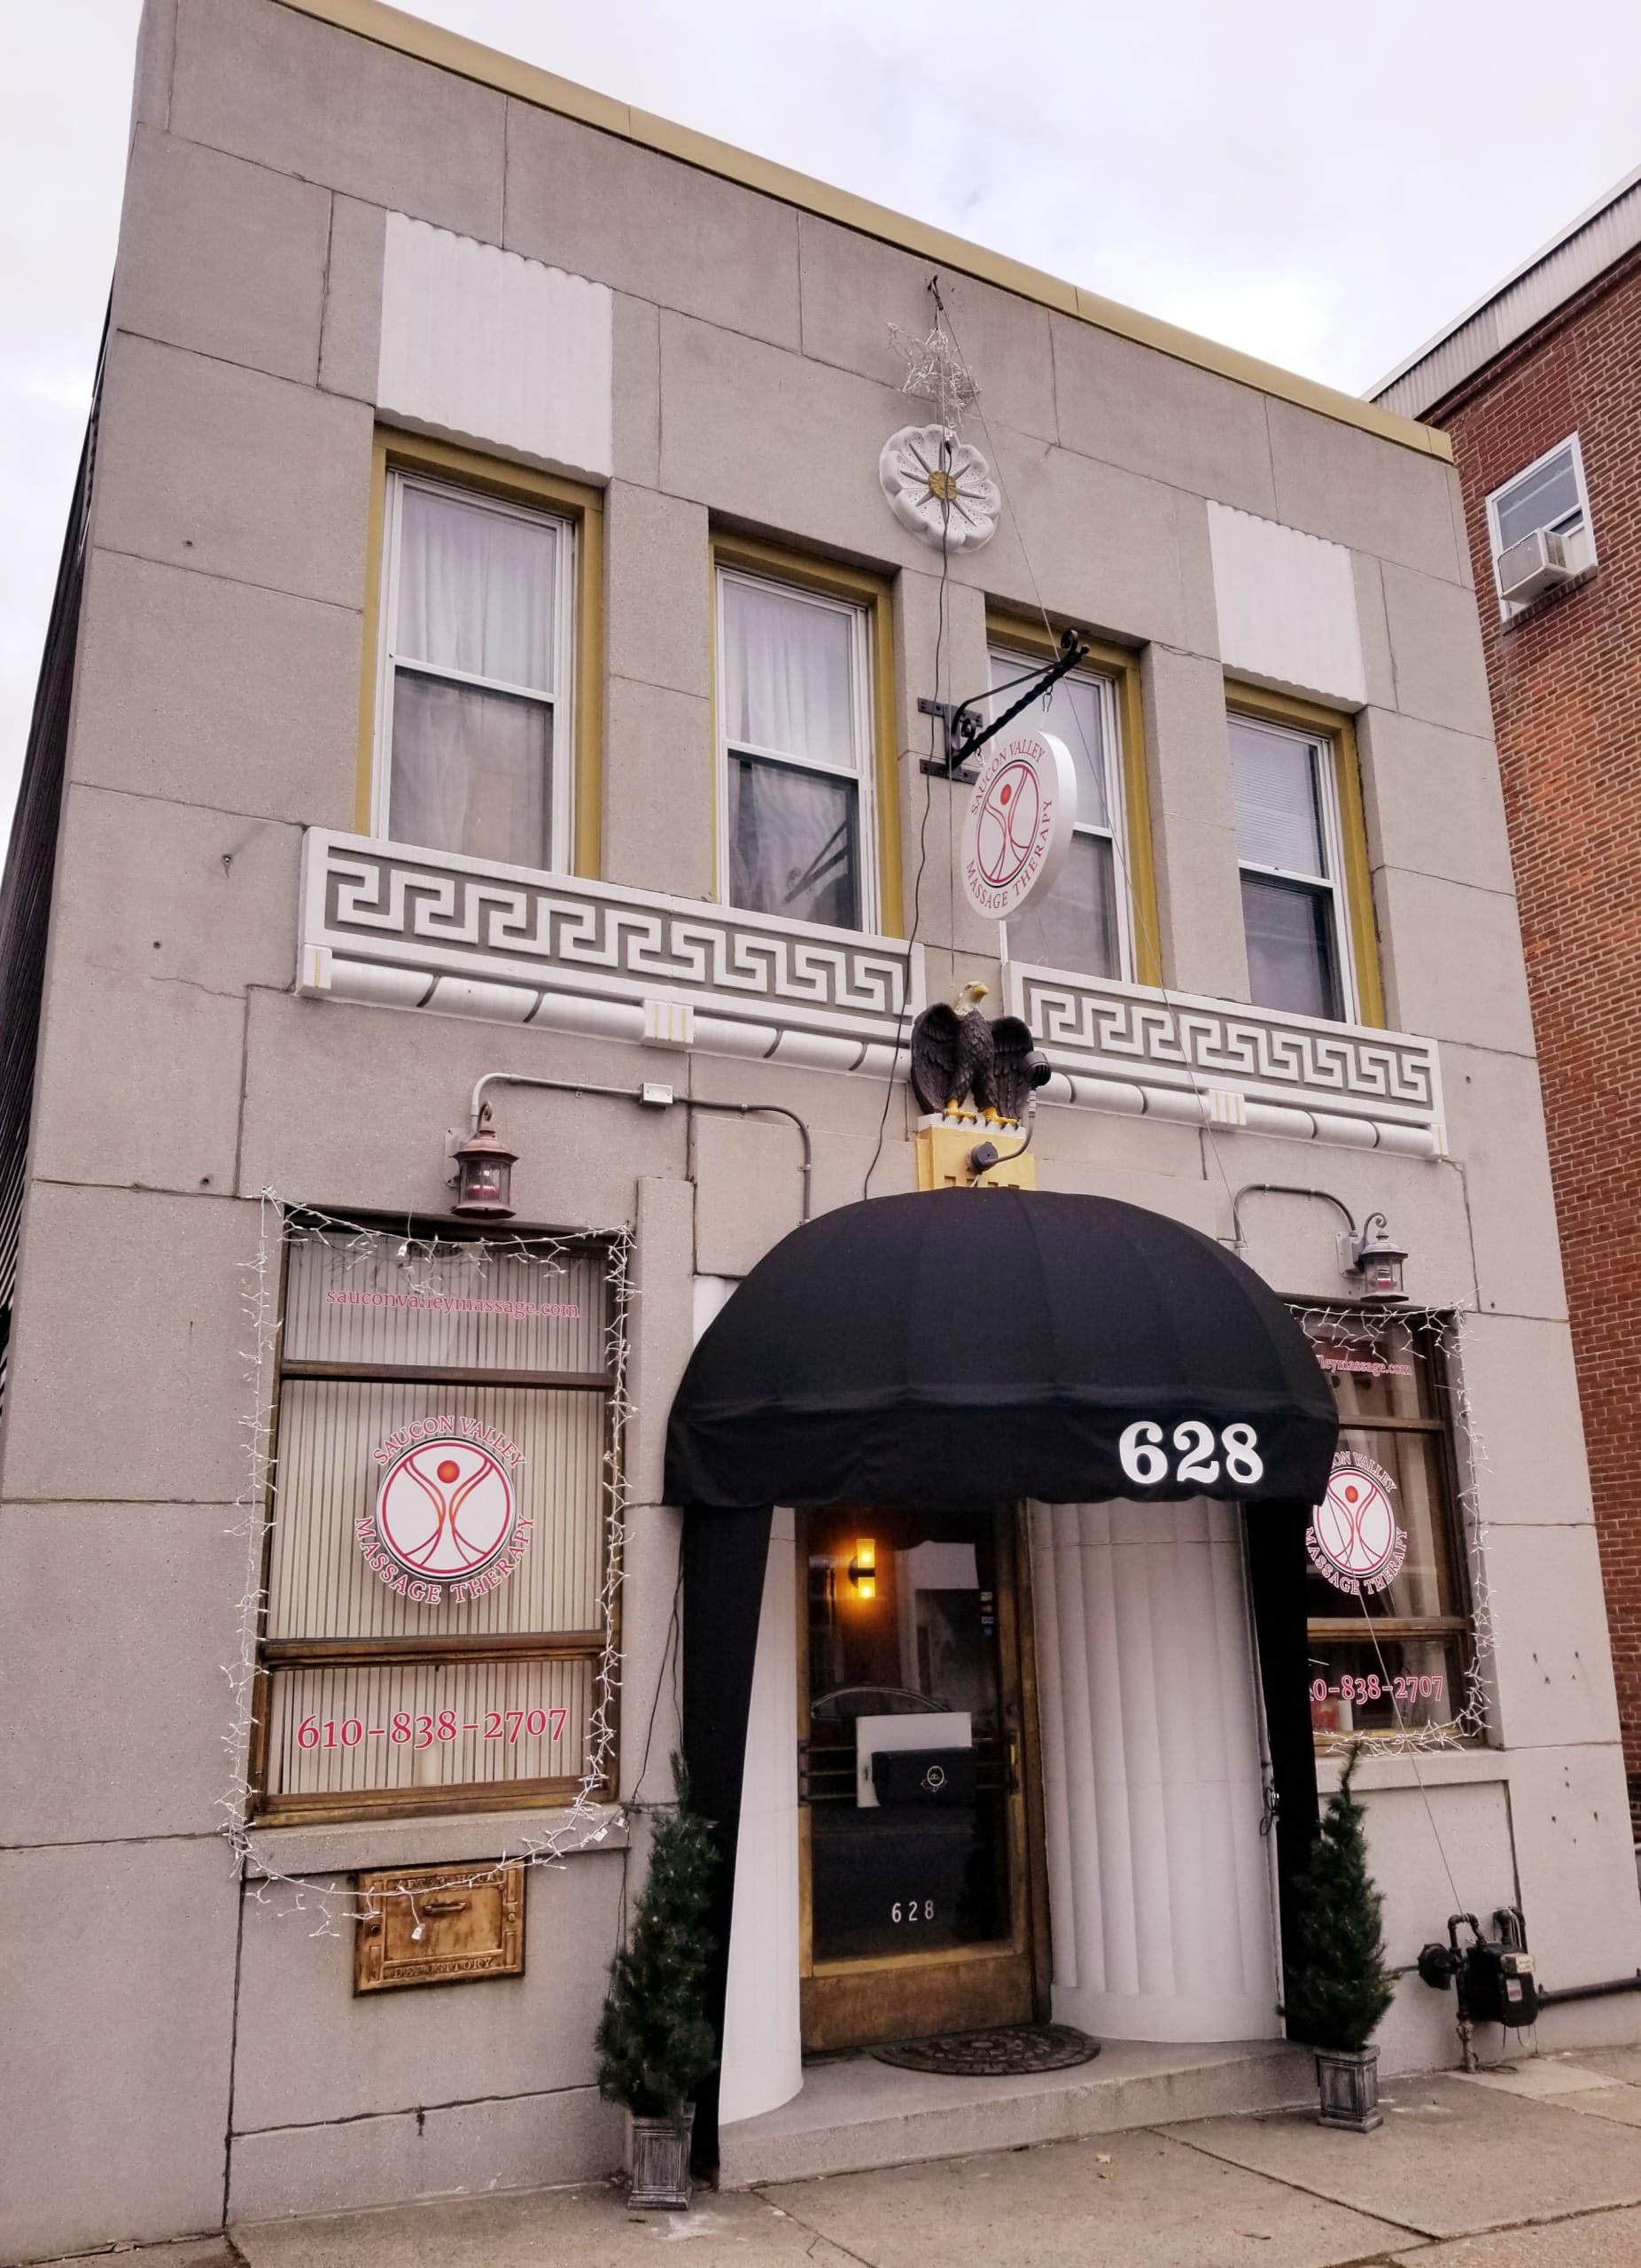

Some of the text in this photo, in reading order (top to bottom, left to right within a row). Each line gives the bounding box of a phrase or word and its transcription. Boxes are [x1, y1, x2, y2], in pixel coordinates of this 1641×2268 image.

[971, 739, 1045, 815] SAUCON VALLEY
[967, 799, 1053, 909] MASSAGE THERAPY
[372, 1415, 527, 1469] SAUCON VALLEY
[1119, 1420, 1264, 1484] 628
[1352, 1451, 1397, 1493] VALLEY
[355, 1513, 534, 1604] MASSAGE THERAPY
[1305, 1526, 1408, 1595] MASSAGE THERAPY
[1310, 1674, 1443, 1705] 0-838-2707
[297, 1708, 568, 1750] 610-838-2707
[891, 1899, 935, 1922] 628
